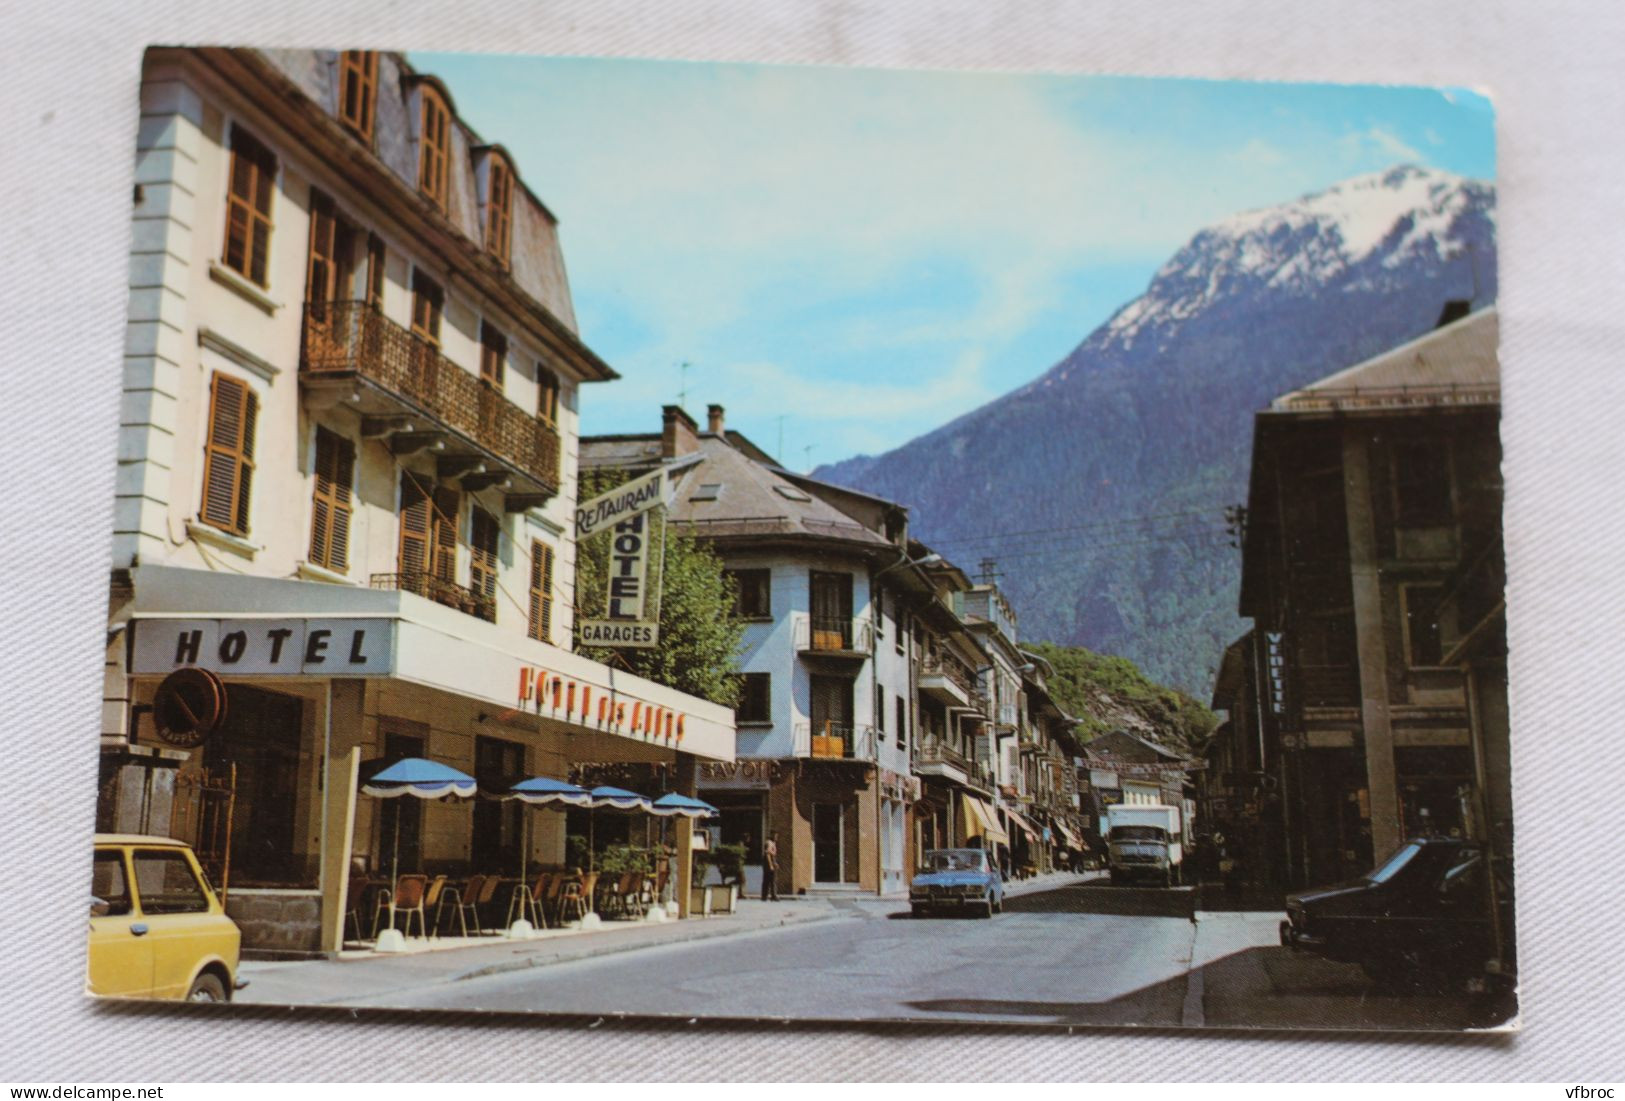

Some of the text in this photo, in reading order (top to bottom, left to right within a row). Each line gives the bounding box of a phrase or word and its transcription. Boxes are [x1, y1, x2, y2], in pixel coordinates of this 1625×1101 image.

[575, 475, 661, 534] RESTAURANT
[609, 513, 643, 619] HOTEL
[175, 628, 367, 664] HOTEL
[583, 625, 652, 643] GARAGES
[700, 759, 782, 781] SAVOIE
